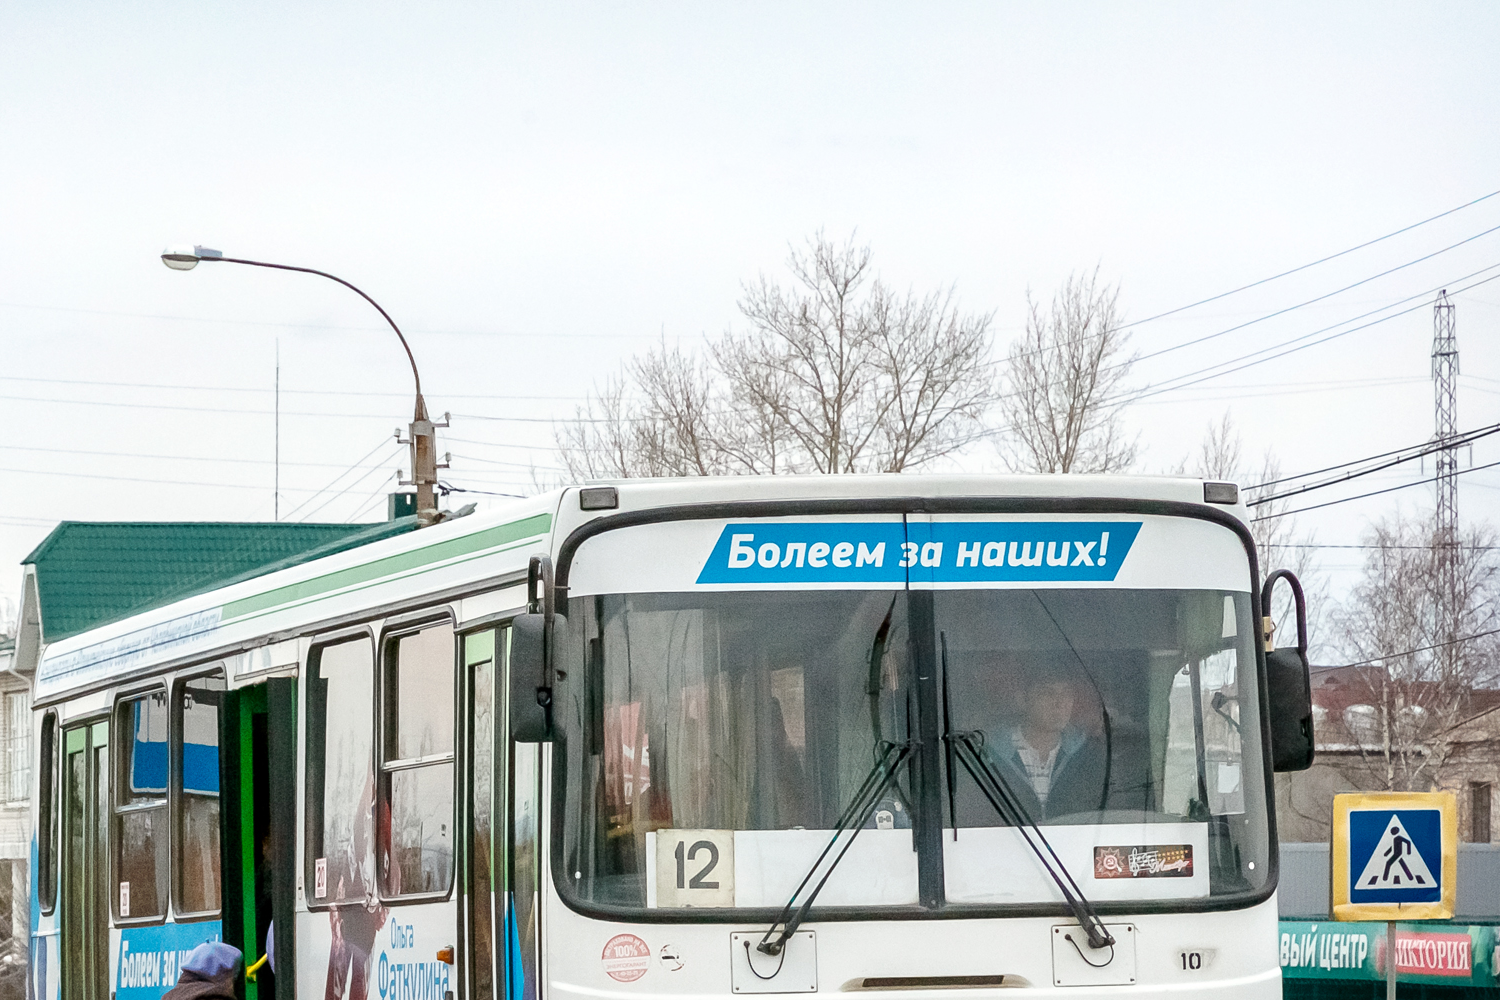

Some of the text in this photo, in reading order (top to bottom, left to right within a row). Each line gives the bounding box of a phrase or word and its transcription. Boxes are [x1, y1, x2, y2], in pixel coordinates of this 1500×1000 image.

[727, 532, 1110, 569] Болеем за наших!
[674, 840, 720, 890] 12
[390, 917, 414, 950] Ольга
[613, 944, 638, 958] 100%
[1319, 932, 1368, 971] ЦЕНТР
[120, 940, 160, 988] Болеем
[162, 950, 175, 987] за
[1181, 952, 1202, 970] 10
